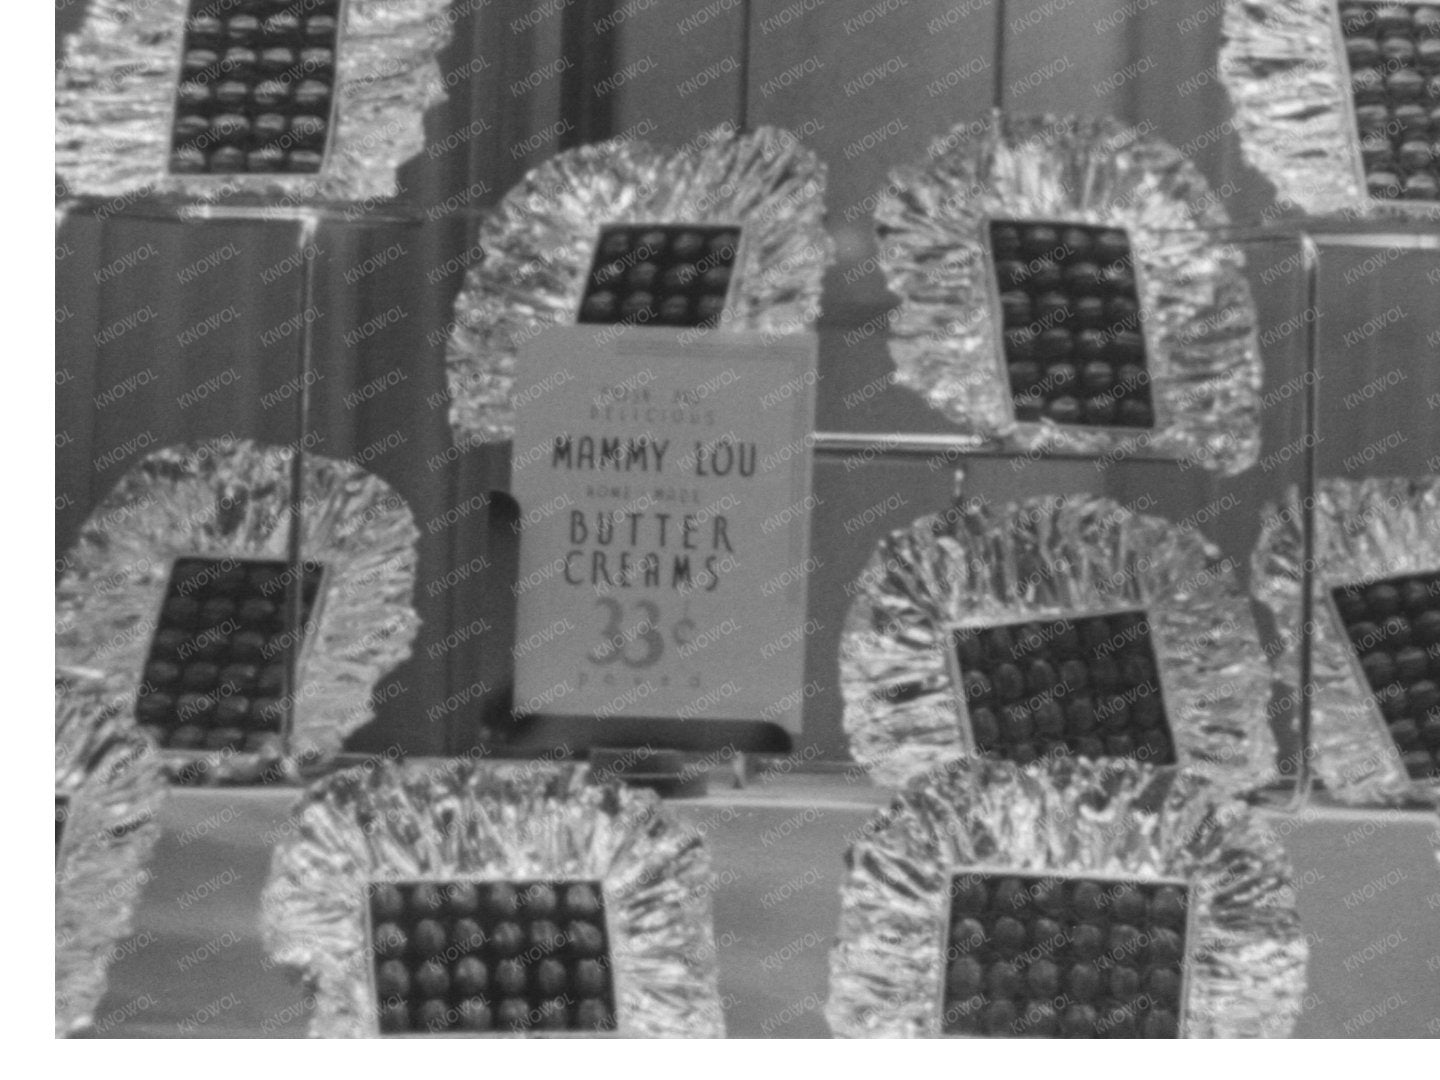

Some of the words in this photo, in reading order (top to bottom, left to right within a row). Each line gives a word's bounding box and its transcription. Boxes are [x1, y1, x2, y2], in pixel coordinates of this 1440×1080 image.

[552, 434, 670, 472] MAMMY
[695, 439, 758, 478] LOU
[569, 508, 734, 555] BUTTER
[564, 548, 720, 593] CREAMS
